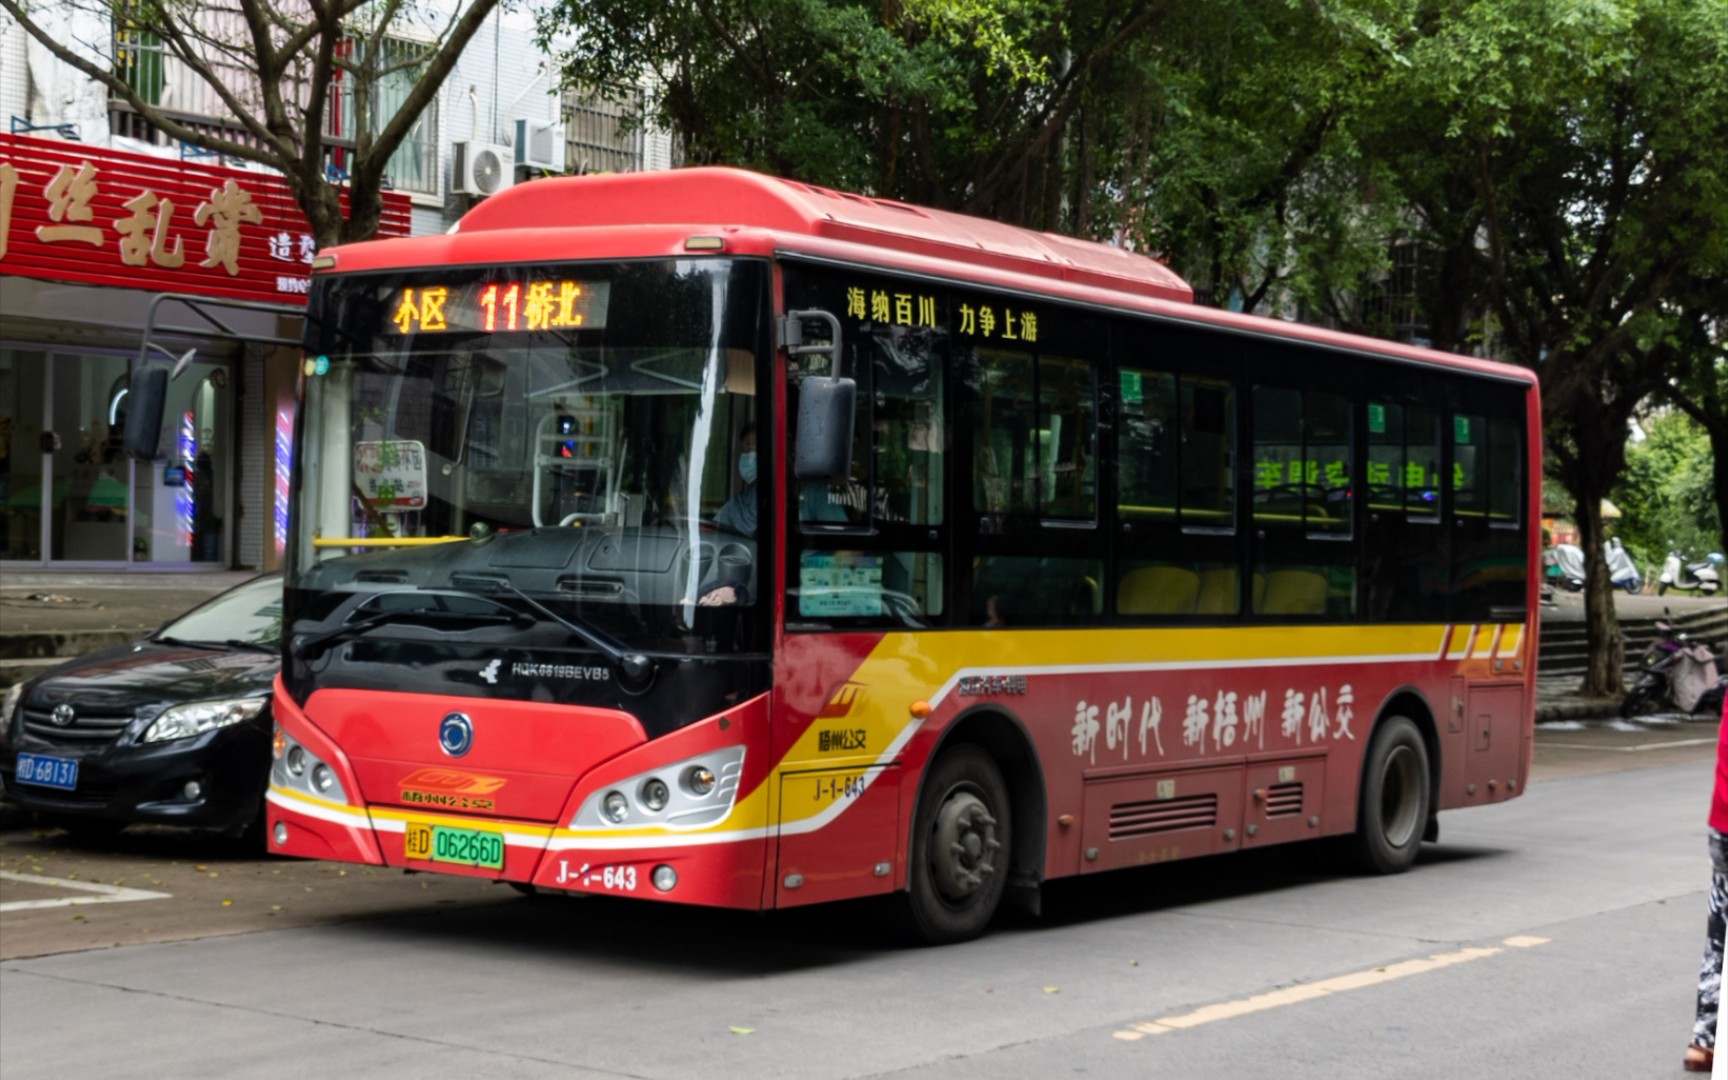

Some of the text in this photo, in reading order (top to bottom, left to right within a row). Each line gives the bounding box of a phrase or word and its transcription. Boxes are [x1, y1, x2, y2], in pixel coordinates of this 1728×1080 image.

[481, 284, 520, 331] 11
[523, 281, 582, 330] 桥北
[847, 287, 1037, 342] 海纳百川 力争上游
[818, 729, 866, 752] 梧州公交
[1071, 684, 1355, 765] 新时代 新梧州 新公交
[813, 776, 865, 801] J-1-643
